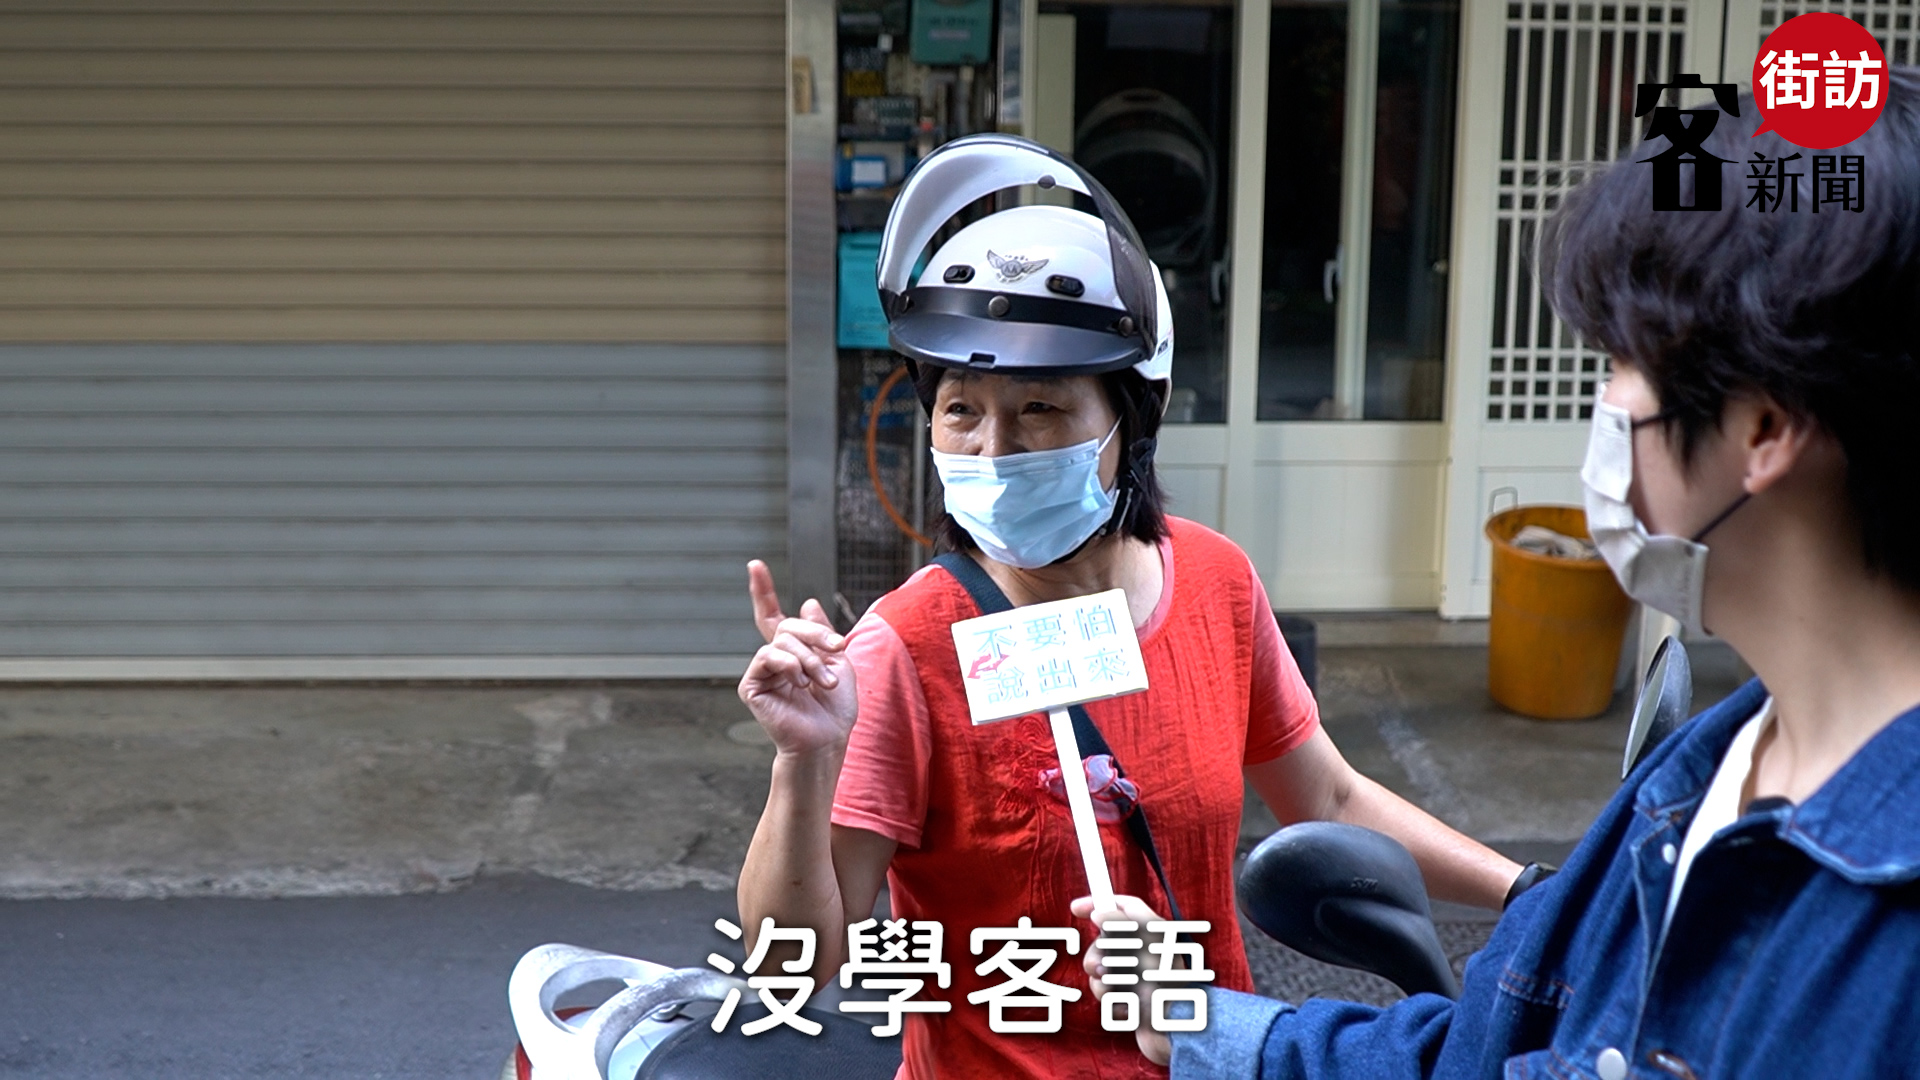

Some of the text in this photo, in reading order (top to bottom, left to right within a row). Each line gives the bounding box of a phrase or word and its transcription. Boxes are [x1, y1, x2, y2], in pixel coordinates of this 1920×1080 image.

[972, 605, 1117, 658] 不要怕
[983, 647, 1129, 704] 說出來
